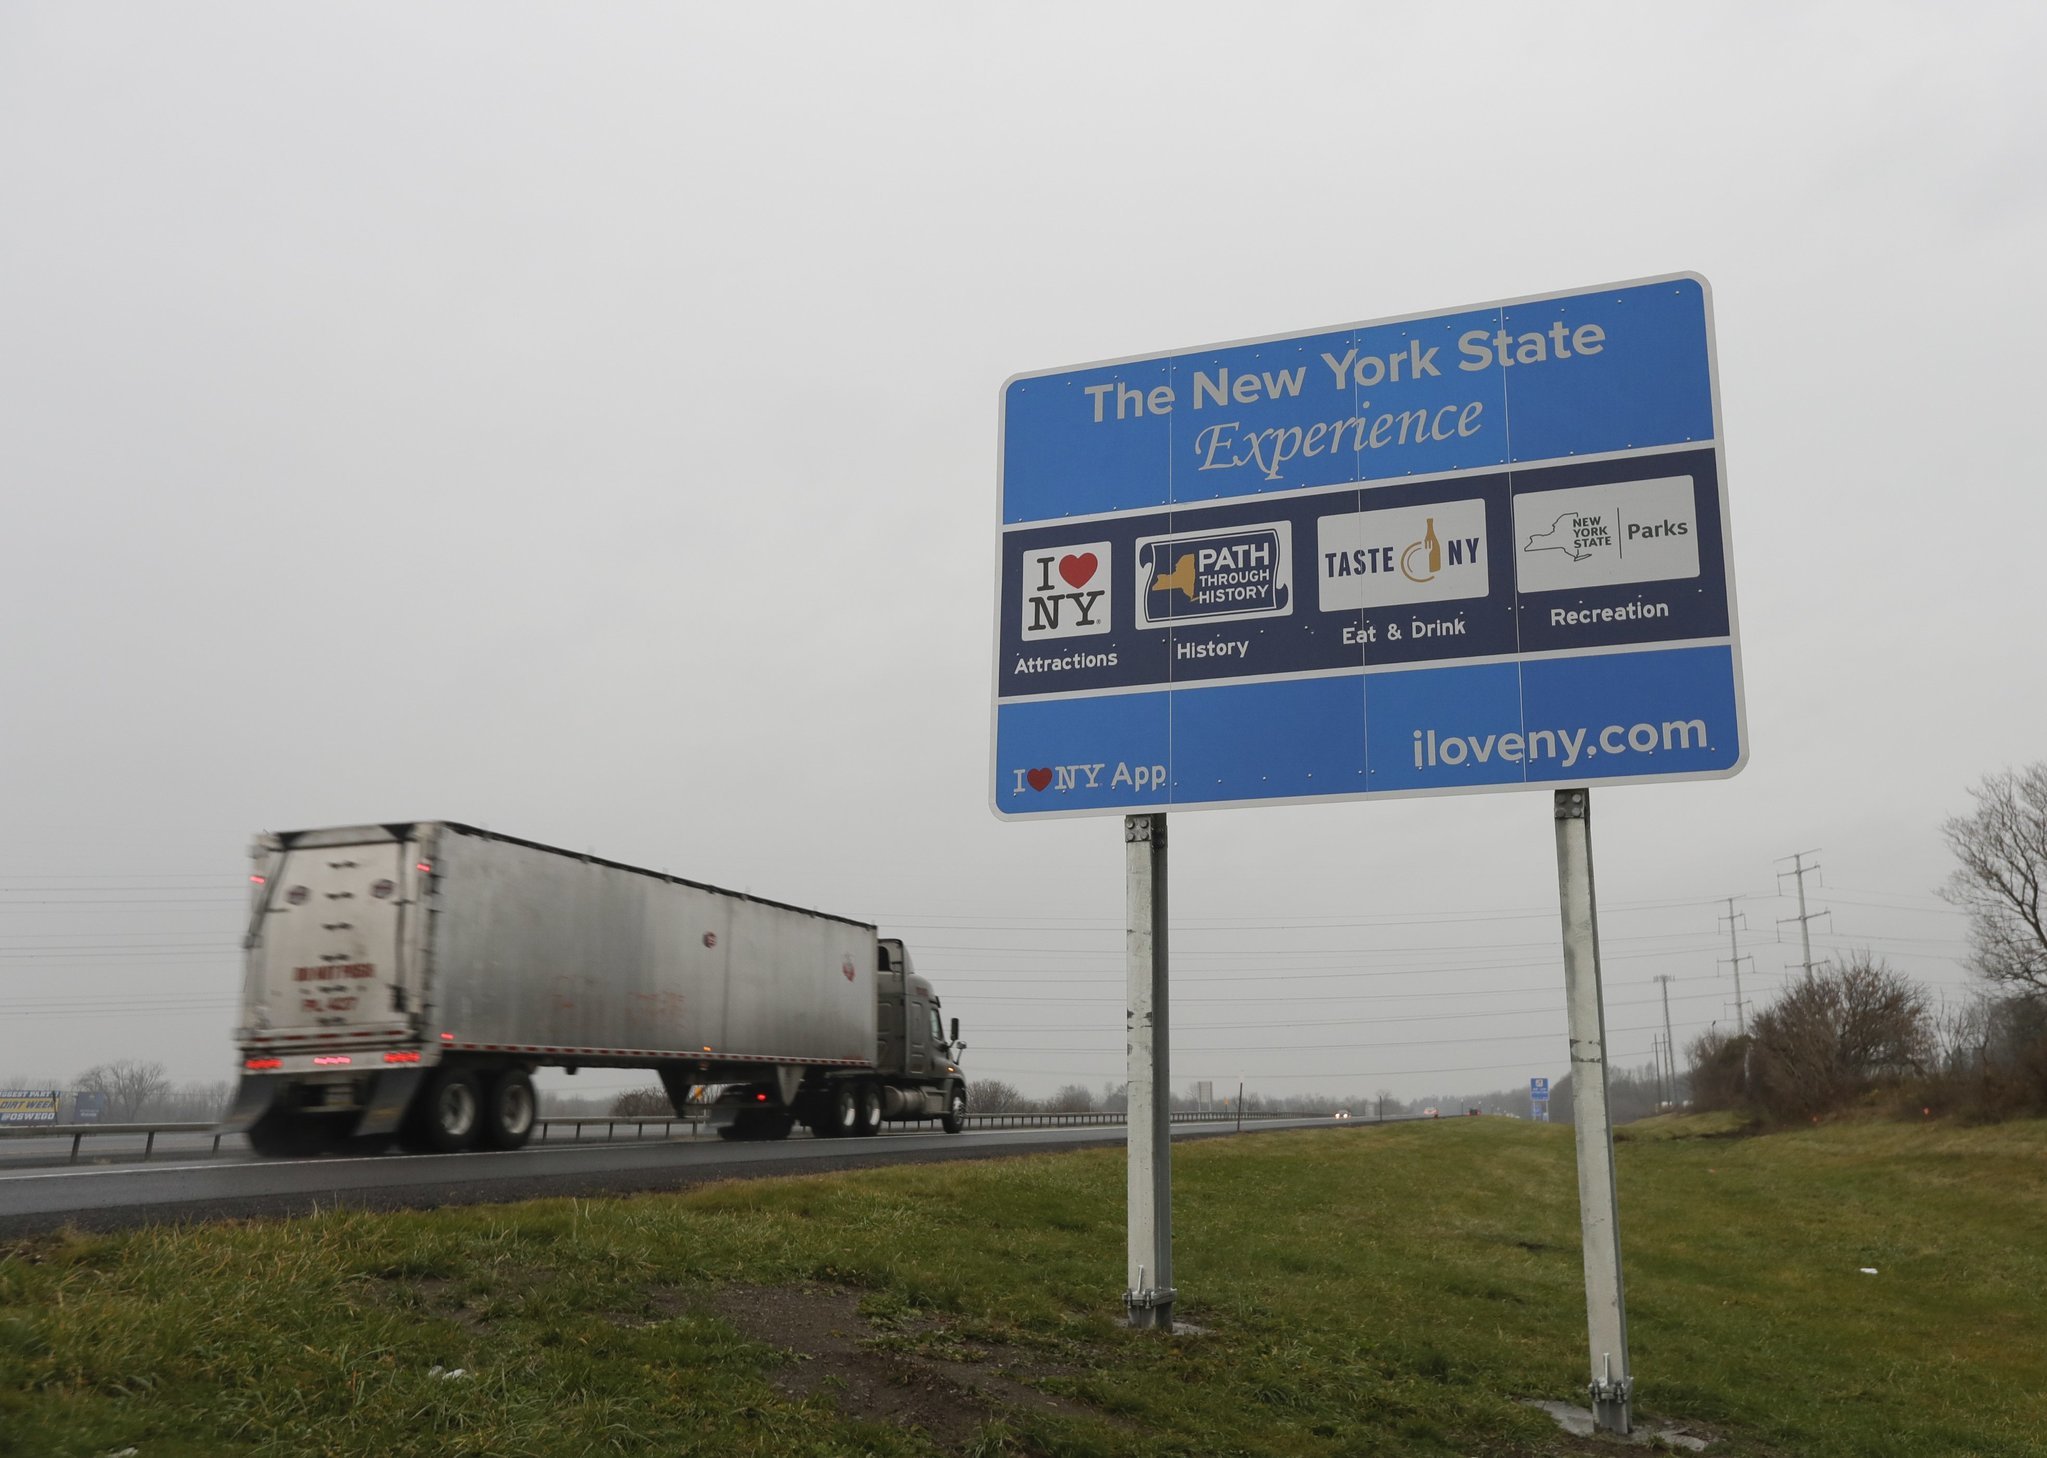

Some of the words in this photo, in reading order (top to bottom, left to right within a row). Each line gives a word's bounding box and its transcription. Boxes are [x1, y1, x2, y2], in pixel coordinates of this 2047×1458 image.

[1084, 381, 1176, 423] The
[1193, 366, 1307, 410] New
[1321, 339, 1442, 390] York
[1458, 321, 1606, 371] State
[1194, 401, 1483, 481] Experience
[1572, 516, 1601, 528] NEW
[1573, 526, 1608, 538] YORK
[1628, 519, 1688, 540] Parks
[1574, 536, 1612, 548] STATE
[1198, 542, 1270, 572] PATH
[1325, 547, 1395, 578] TASTE
[1448, 537, 1479, 566] NY
[1036, 556, 1055, 591] I
[1199, 569, 1270, 587] THROUGH
[1199, 584, 1269, 604] HISTORY
[1027, 590, 1105, 631] NY
[1551, 602, 1669, 626] Recreation
[1342, 625, 1376, 645] Eat
[1387, 623, 1402, 640] &
[1411, 618, 1466, 639] Drink
[1177, 640, 1249, 660] History
[1014, 652, 1118, 675] Attractions
[1413, 719, 1707, 767] iloveny.com
[1013, 768, 1026, 793] I
[1054, 763, 1105, 790] NY
[1111, 762, 1166, 792] App
